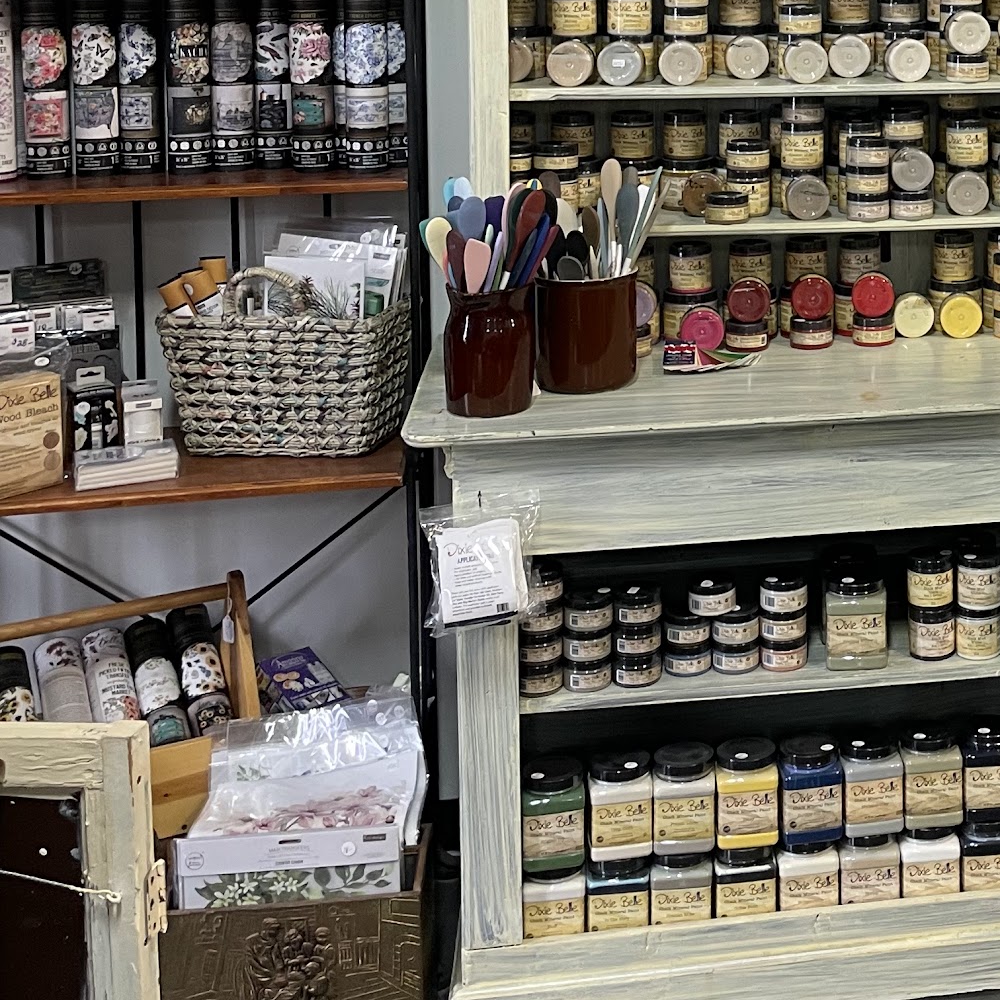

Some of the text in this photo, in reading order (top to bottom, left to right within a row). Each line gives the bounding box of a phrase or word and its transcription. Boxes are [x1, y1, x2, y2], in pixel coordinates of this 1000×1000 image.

[553, 2, 590, 12] Dixie Belle
[614, 3, 633, 12] Dixie
[670, 128, 689, 138] Dixie
[725, 128, 744, 138] Dixie
[966, 134, 982, 144] Belle
[784, 137, 819, 147] Dixie Belle
[688, 261, 706, 271] Belle
[30, 385, 58, 402] Belle
[26, 404, 59, 417] Bleach
[444, 543, 474, 556] Dixie
[912, 574, 932, 586] Dixie
[959, 574, 997, 586] Dixie Belle
[833, 617, 882, 630] Dixie Belle
[958, 624, 997, 636] Dixie Belle
[919, 627, 940, 637] Dixie
[914, 772, 962, 787] Dixie Belle
[970, 769, 993, 781] Dixie
[852, 781, 898, 796] Dixie Belle
[726, 793, 774, 808] Dixie Belle
[790, 788, 839, 804] Dixie Belle
[599, 804, 648, 819] Dixie Belle
[662, 800, 709, 813] Dixie Belle
[529, 815, 578, 831] Dixie Belle
[907, 863, 954, 877] Dixie Belle
[967, 860, 990, 871] Dixie
[848, 869, 895, 883] Dixie Belle
[787, 876, 836, 891] Dixie Belle
[721, 883, 770, 898] Dixie Belle
[592, 896, 643, 909] Dixie Belle
[655, 892, 706, 905] Dixie Belle
[529, 903, 577, 916] Dixie Belle
